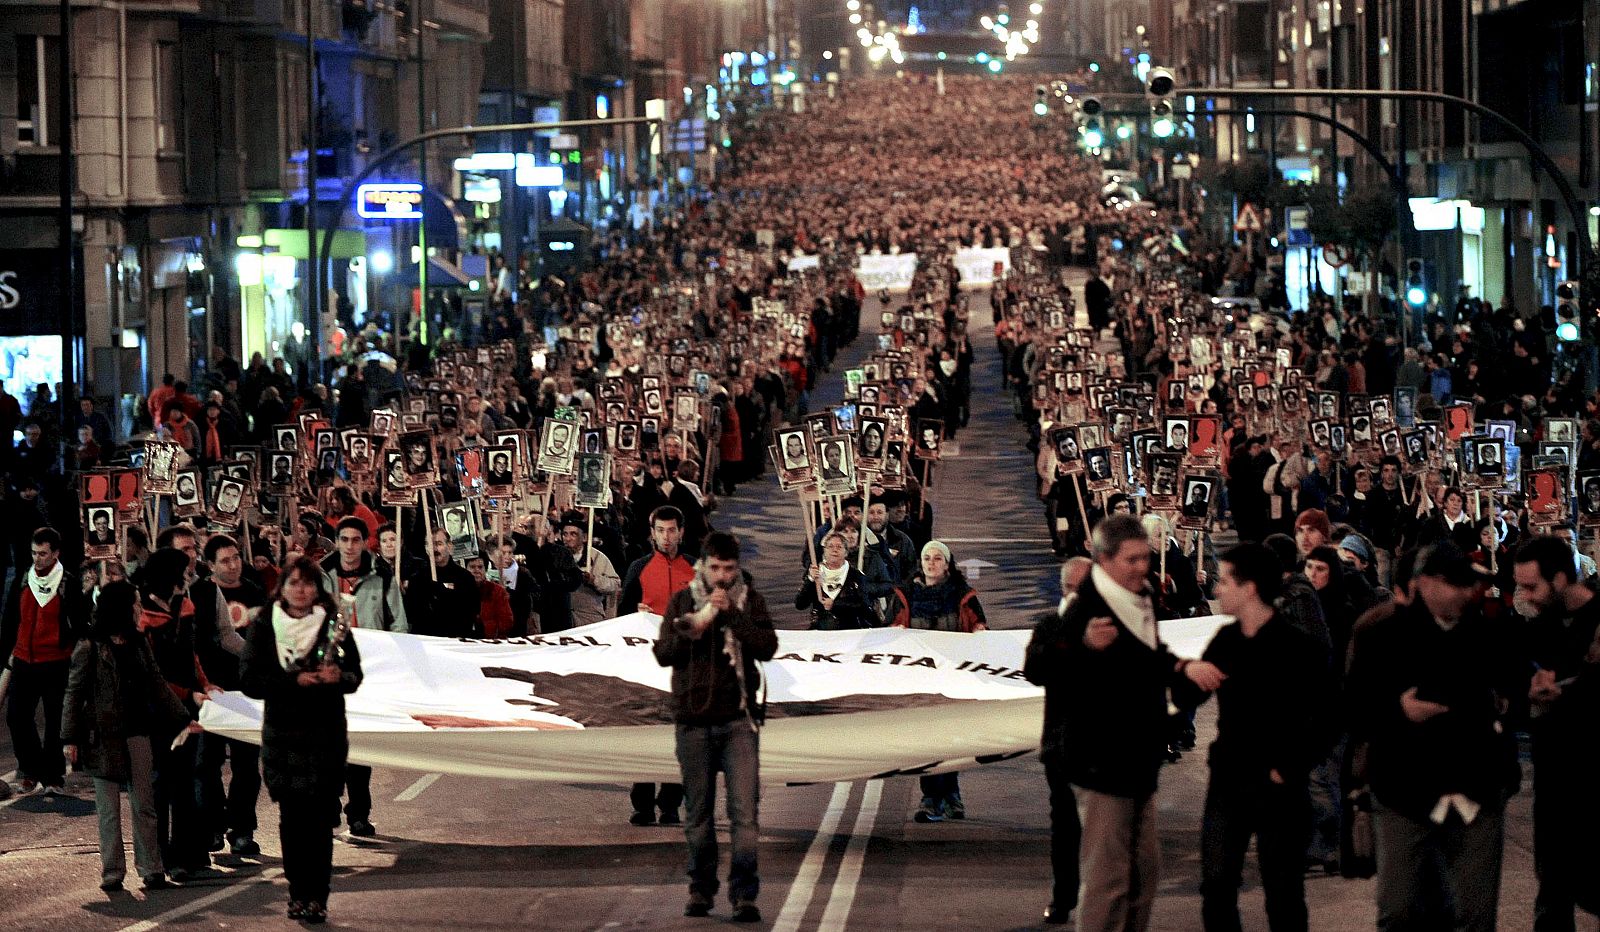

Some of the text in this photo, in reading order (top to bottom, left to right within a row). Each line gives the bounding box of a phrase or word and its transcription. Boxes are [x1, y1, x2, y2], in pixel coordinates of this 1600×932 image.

[0, 270, 20, 309] S
[861, 653, 937, 669] ETA
[955, 660, 1028, 681] IHE
